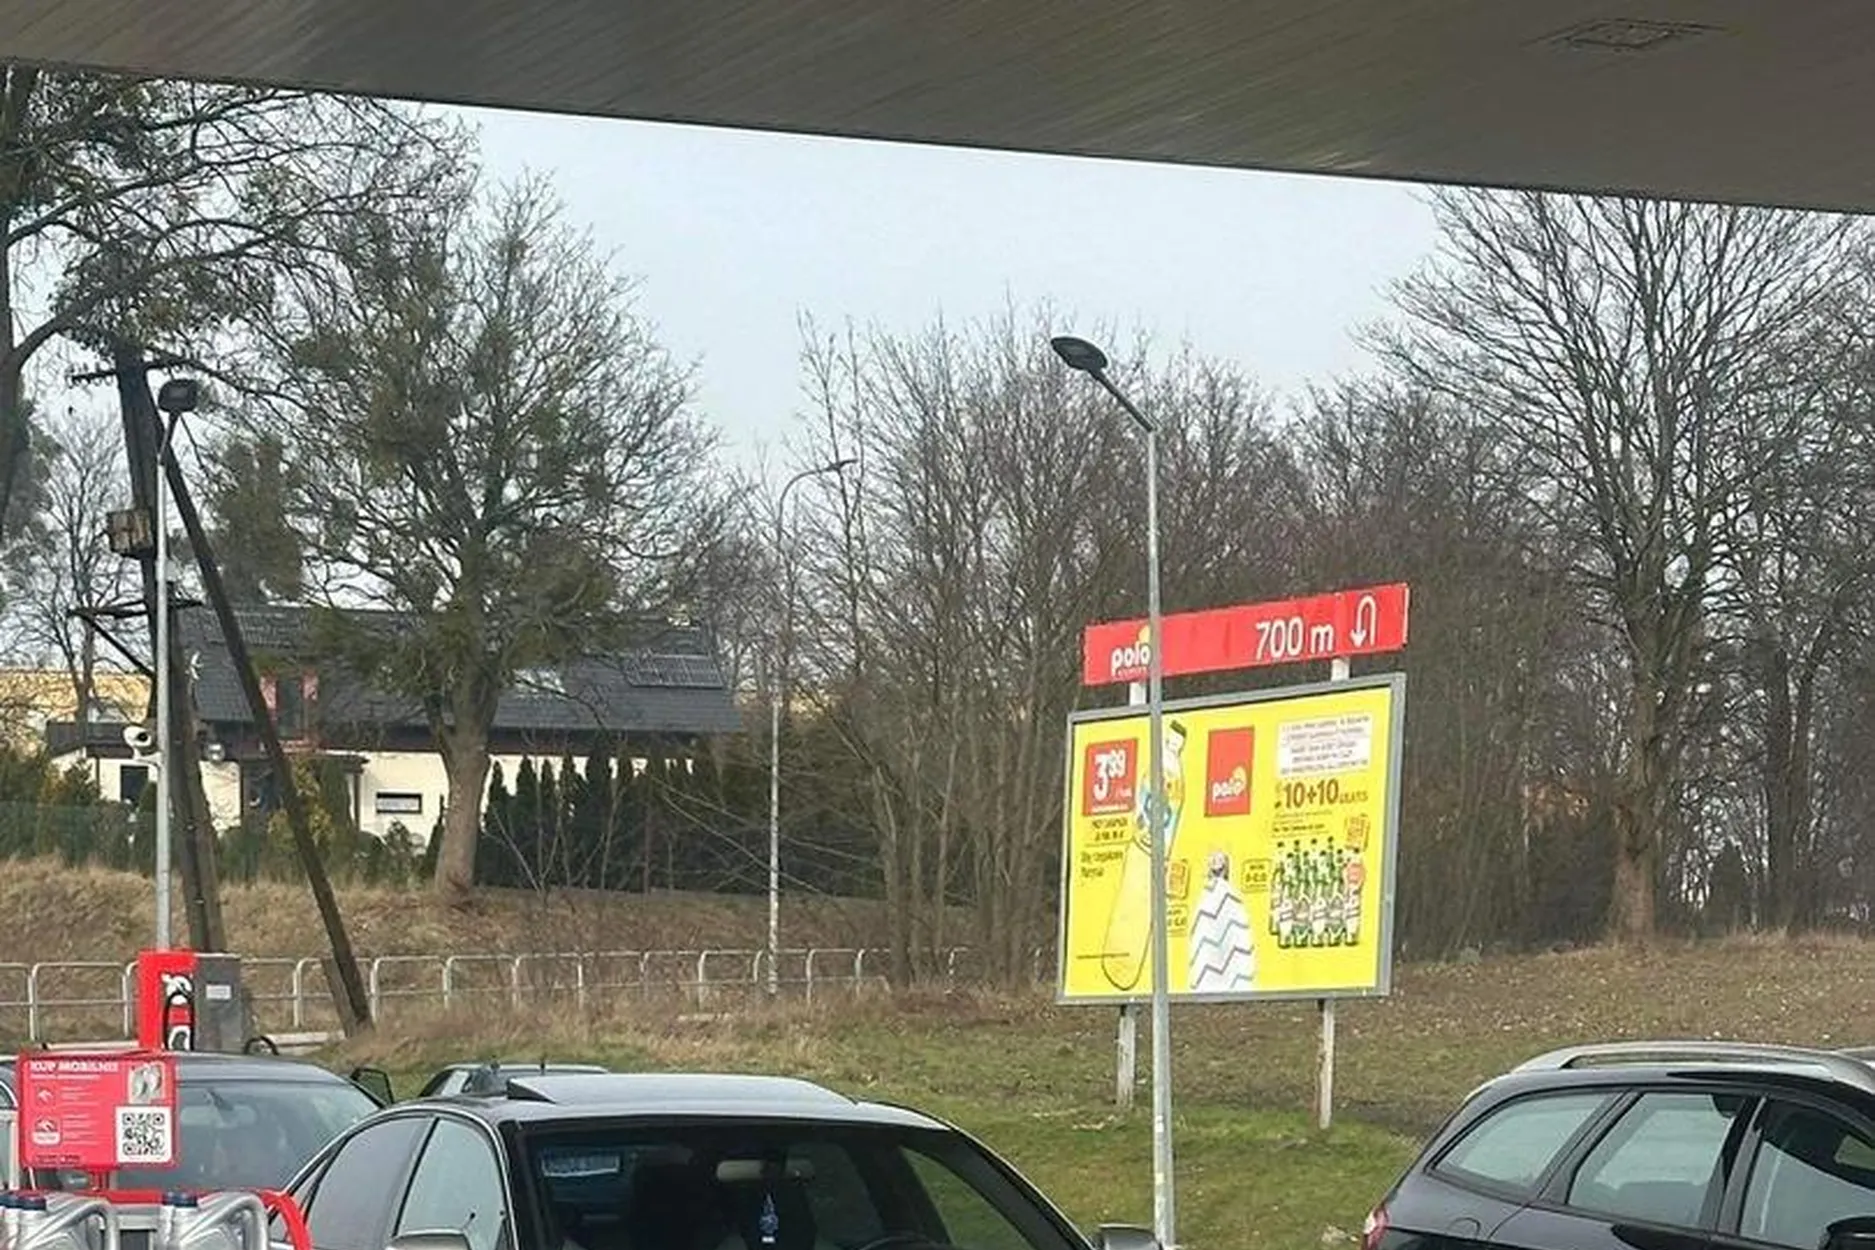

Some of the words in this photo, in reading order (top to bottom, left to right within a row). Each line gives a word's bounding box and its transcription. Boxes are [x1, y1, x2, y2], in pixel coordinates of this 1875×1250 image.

[1256, 617, 1304, 660] 700
[1310, 623, 1335, 653] m
[1282, 778, 1339, 809] 10+10
